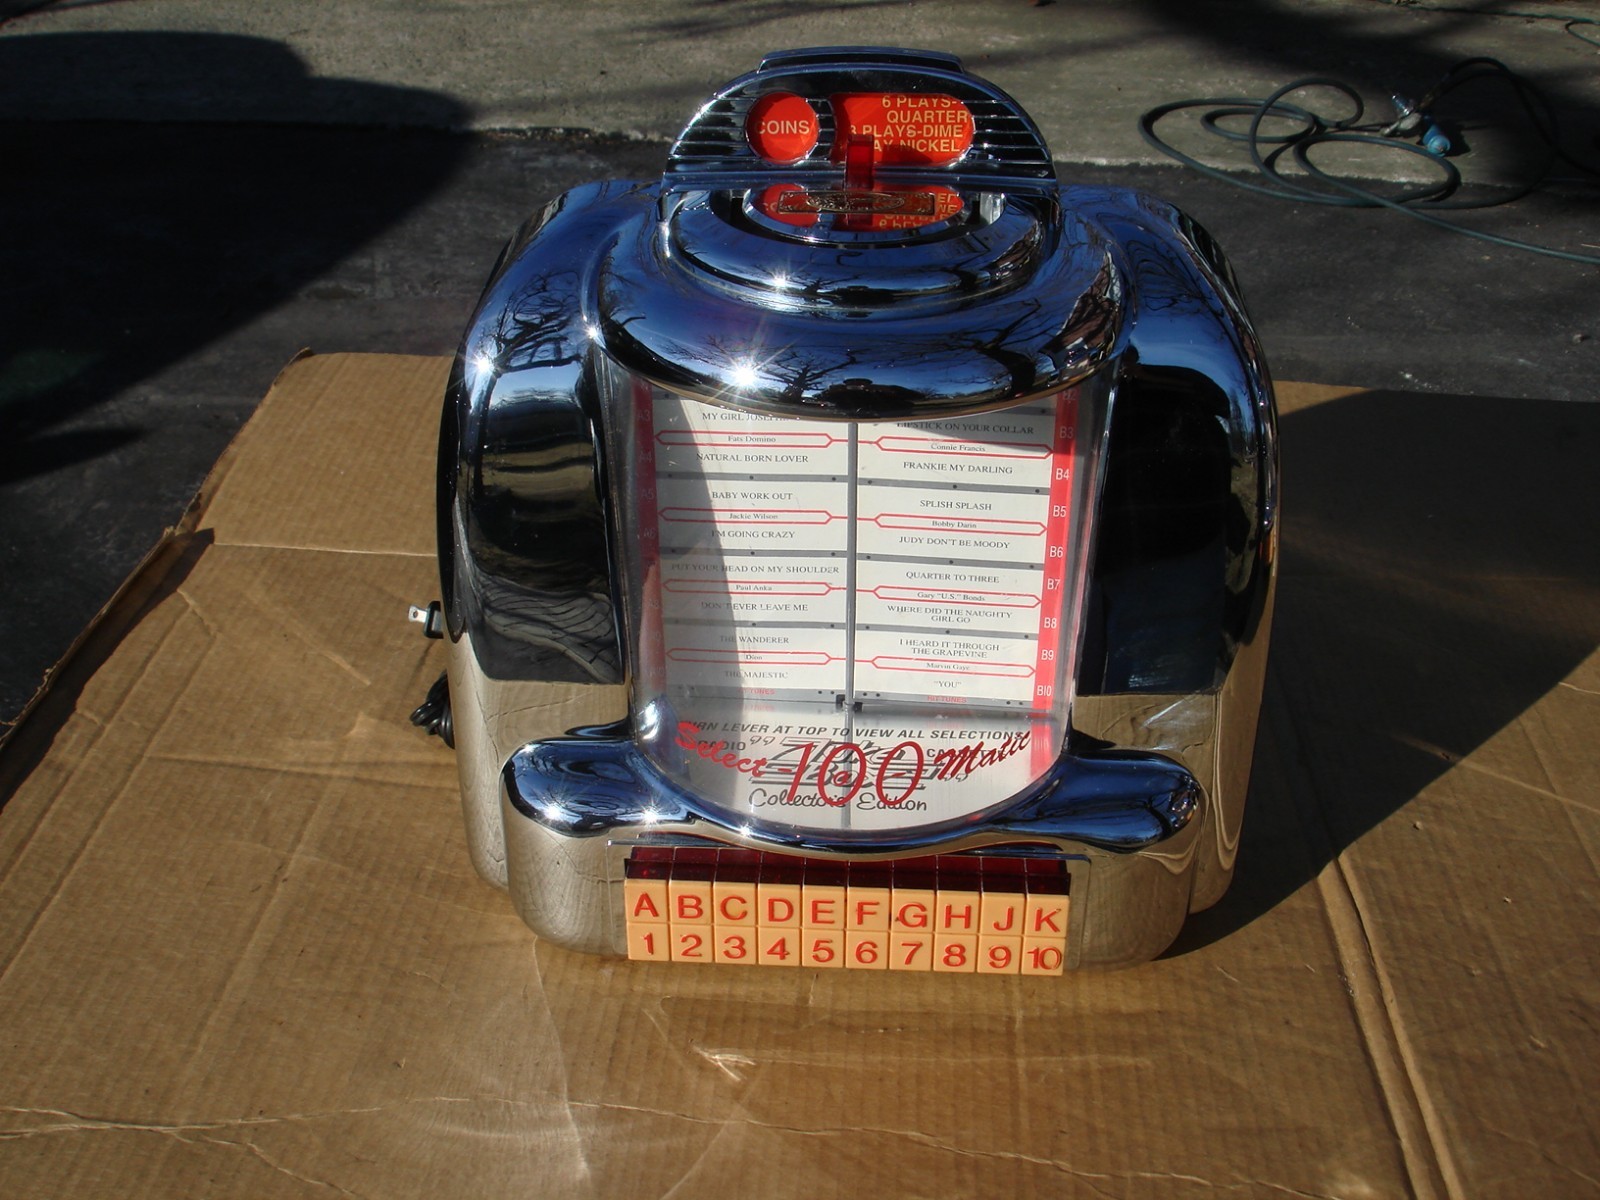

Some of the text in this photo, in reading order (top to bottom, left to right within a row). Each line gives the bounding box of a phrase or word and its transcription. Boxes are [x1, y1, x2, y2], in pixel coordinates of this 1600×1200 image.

[882, 95, 891, 108] 6
[886, 110, 968, 123] QUARTER
[756, 120, 810, 135] COINS
[862, 125, 963, 138] PLAYS-DIME
[702, 412, 719, 421] MY
[720, 413, 743, 421] GIRL
[944, 422, 961, 431] ON
[963, 423, 991, 433] YOUR
[993, 425, 1034, 434] COLLAR
[1060, 426, 1073, 439] B3
[728, 435, 776, 443] Fats Domino
[931, 443, 957, 451] Connie
[696, 453, 809, 463] NATURAL BORN LOVER
[903, 461, 1013, 474] FRANKIE MY DARLING
[1056, 468, 1070, 481] B4
[712, 491, 738, 499] BABY
[740, 492, 770, 500] WORK
[920, 500, 992, 511] SPLISH SPLASH
[1053, 505, 1067, 518] B5
[932, 520, 954, 529] Bobby
[727, 530, 759, 538] GOING
[761, 531, 795, 539] CRAZY
[899, 536, 1010, 549] JUDY DON'T BE MOODY
[1050, 546, 1064, 558] B6
[690, 564, 719, 572] YOUR
[721, 565, 748, 573] HEAD
[750, 565, 765, 573] ON
[786, 566, 839, 574] SHOULDER
[906, 571, 999, 583] QUARTER TO THREE
[1047, 578, 1061, 590] B7
[917, 592, 935, 600] Gary
[733, 602, 757, 611] EVER
[760, 603, 790, 611] LEAVE
[887, 605, 1013, 619] WHERE DID THE NAUGHTY
[931, 615, 954, 623] GIRL
[1044, 617, 1057, 629] B8
[720, 635, 789, 644] THE WANDERER
[905, 639, 939, 648] HEARD
[953, 642, 1000, 651] THROUGH
[932, 648, 988, 658] GRAPEVINE
[1041, 649, 1054, 661] B9
[926, 662, 951, 670] Marvin
[725, 670, 788, 679] THE MAJESTIC
[1037, 685, 1052, 697] B10
[721, 723, 769, 733] LEVER
[773, 725, 792, 734] AT
[796, 726, 827, 735] TOP
[832, 727, 850, 736] TO
[855, 729, 894, 738] VIEW
[897, 730, 925, 739] ALL
[634, 892, 1061, 933] A B C D E F G H J K
[643, 932, 1062, 970] 1 2 3 4 5 6 7 8 9 10
